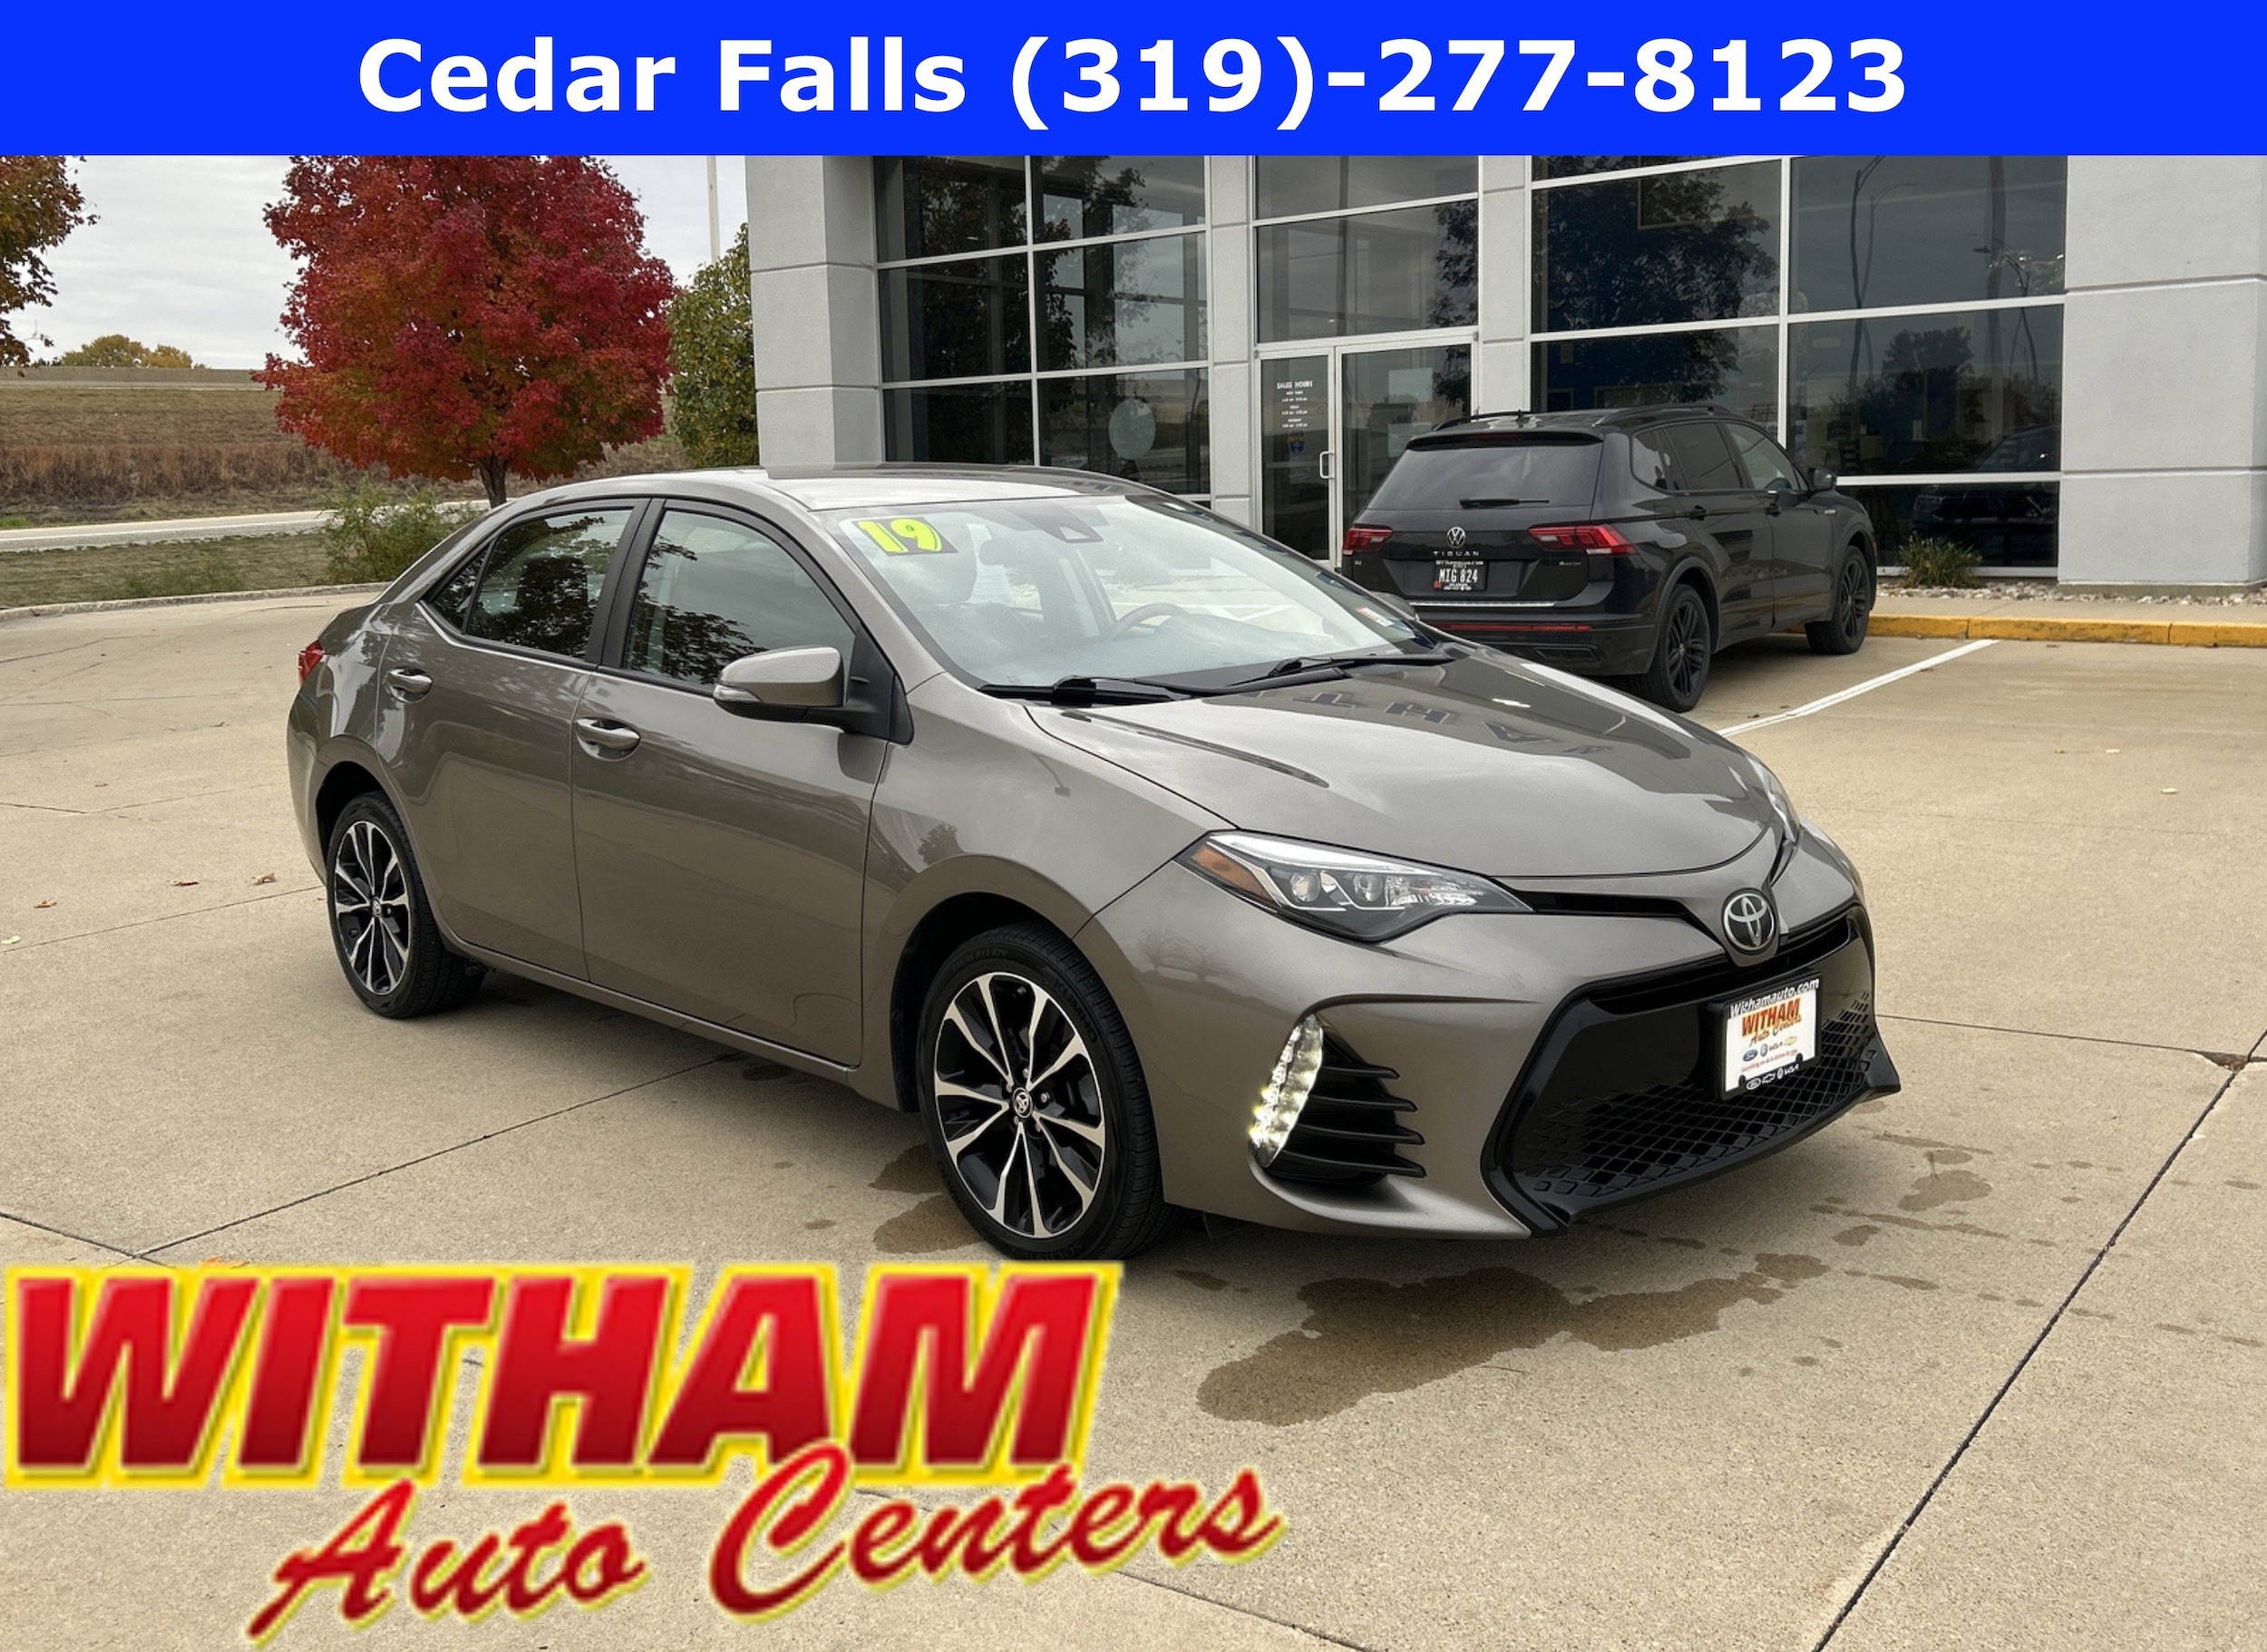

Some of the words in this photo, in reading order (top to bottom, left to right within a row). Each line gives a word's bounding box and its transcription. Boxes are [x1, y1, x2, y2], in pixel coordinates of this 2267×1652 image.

[858, 518, 942, 553] 19
[1439, 568, 1457, 583] MIG
[1460, 568, 1478, 583] 824
[1053, 978, 1098, 1044] KUMHO
[1742, 997, 1801, 1037] WITHAM
